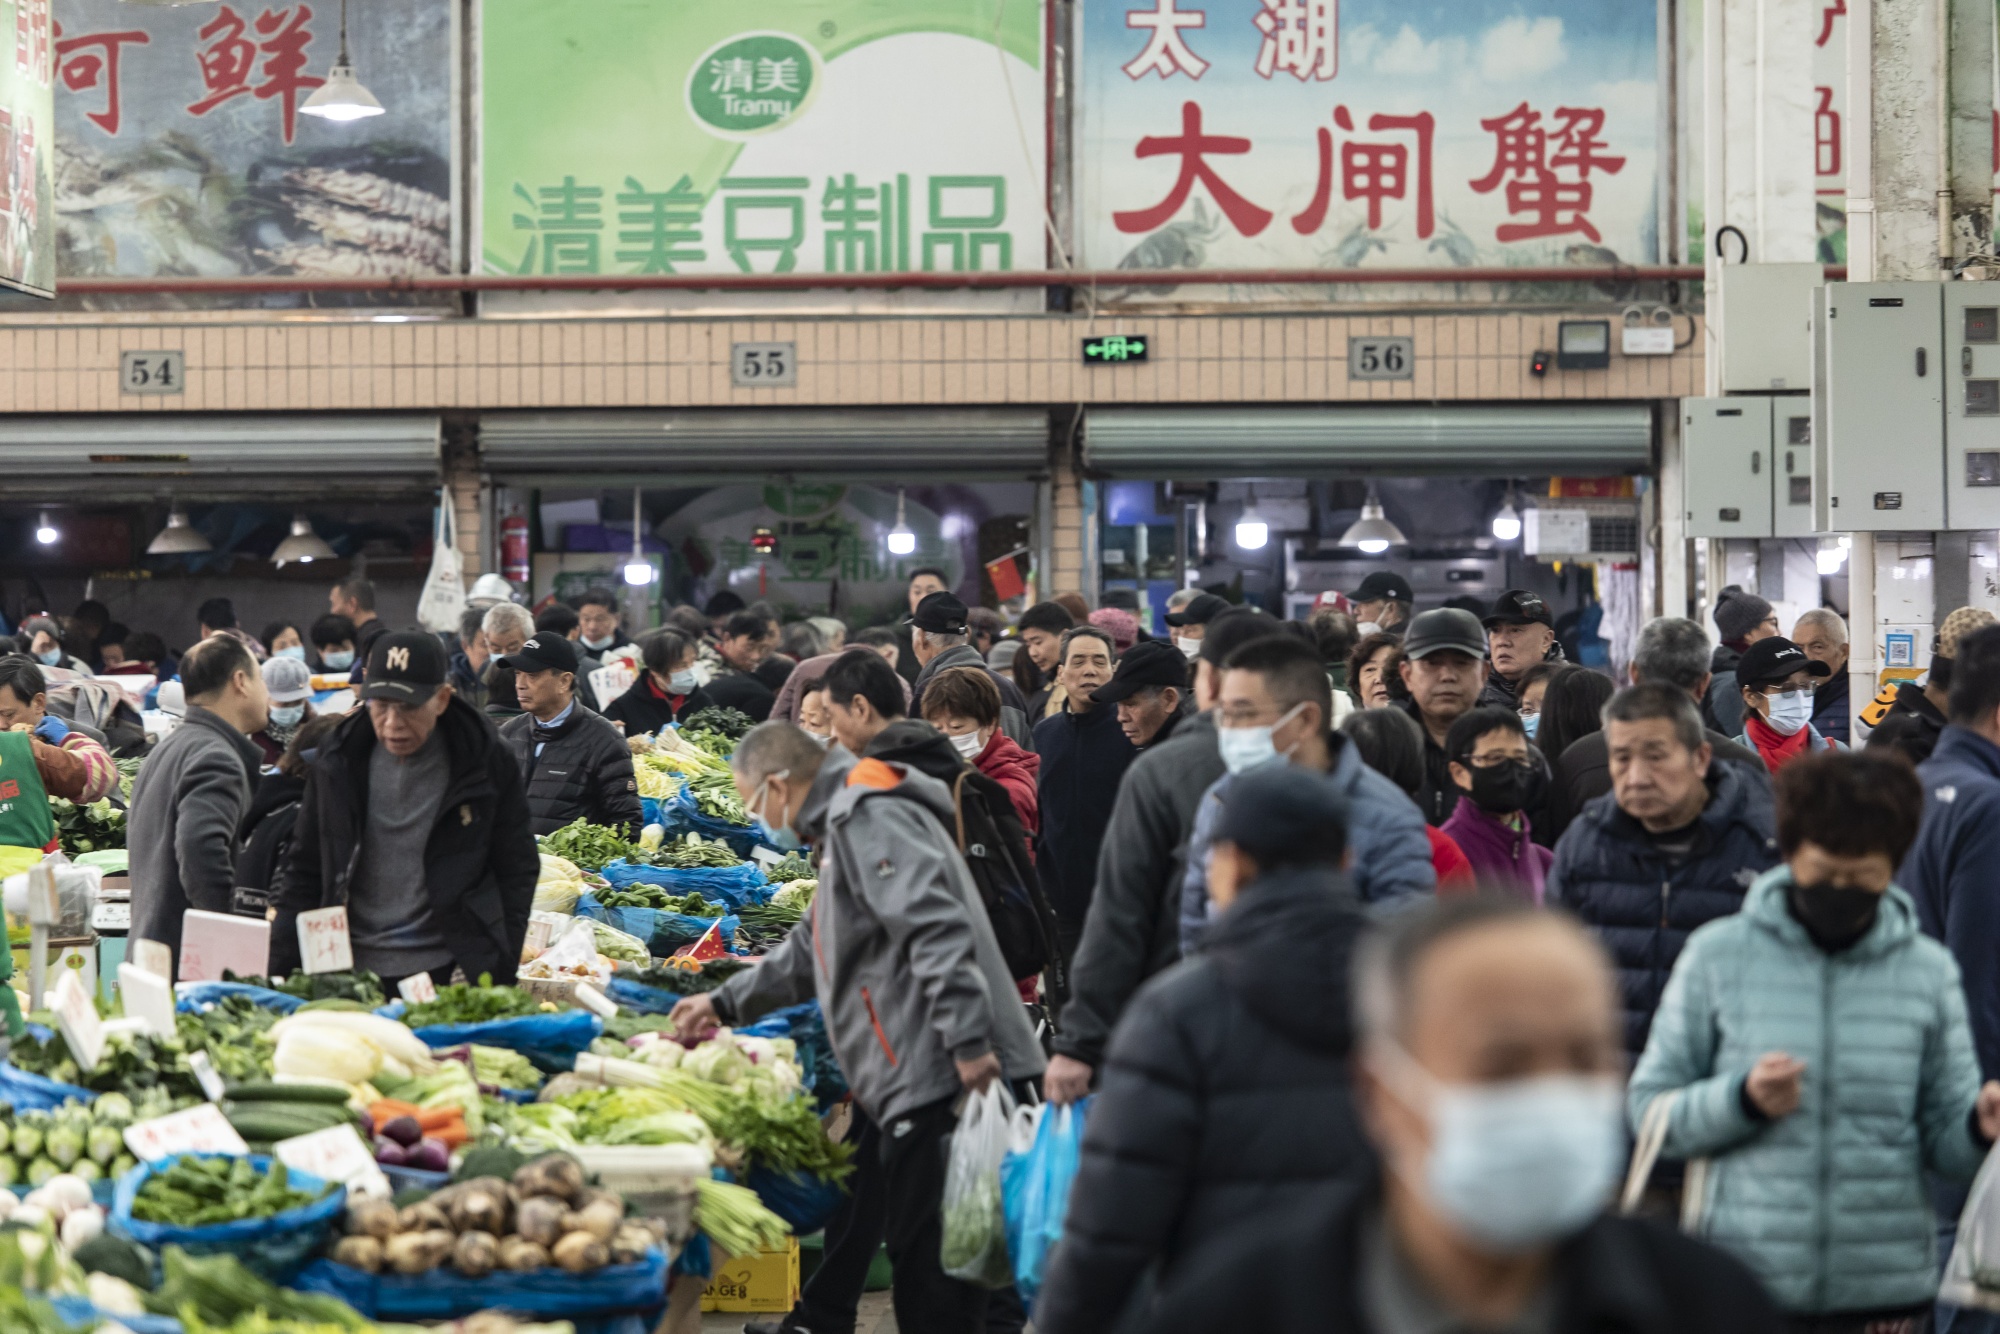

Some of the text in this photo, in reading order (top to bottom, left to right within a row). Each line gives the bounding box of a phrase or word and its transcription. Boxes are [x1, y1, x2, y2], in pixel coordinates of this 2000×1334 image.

[1120, 0, 1340, 82] 太湖
[53, 4, 327, 147] 河鲜
[709, 56, 800, 93] 清美
[719, 93, 793, 122] Tramy
[1112, 101, 1627, 243] 大闸蟹
[513, 173, 1012, 276] 清美豆制品
[130, 358, 174, 387] 54
[743, 350, 786, 379] 55
[1360, 345, 1404, 372] 56
